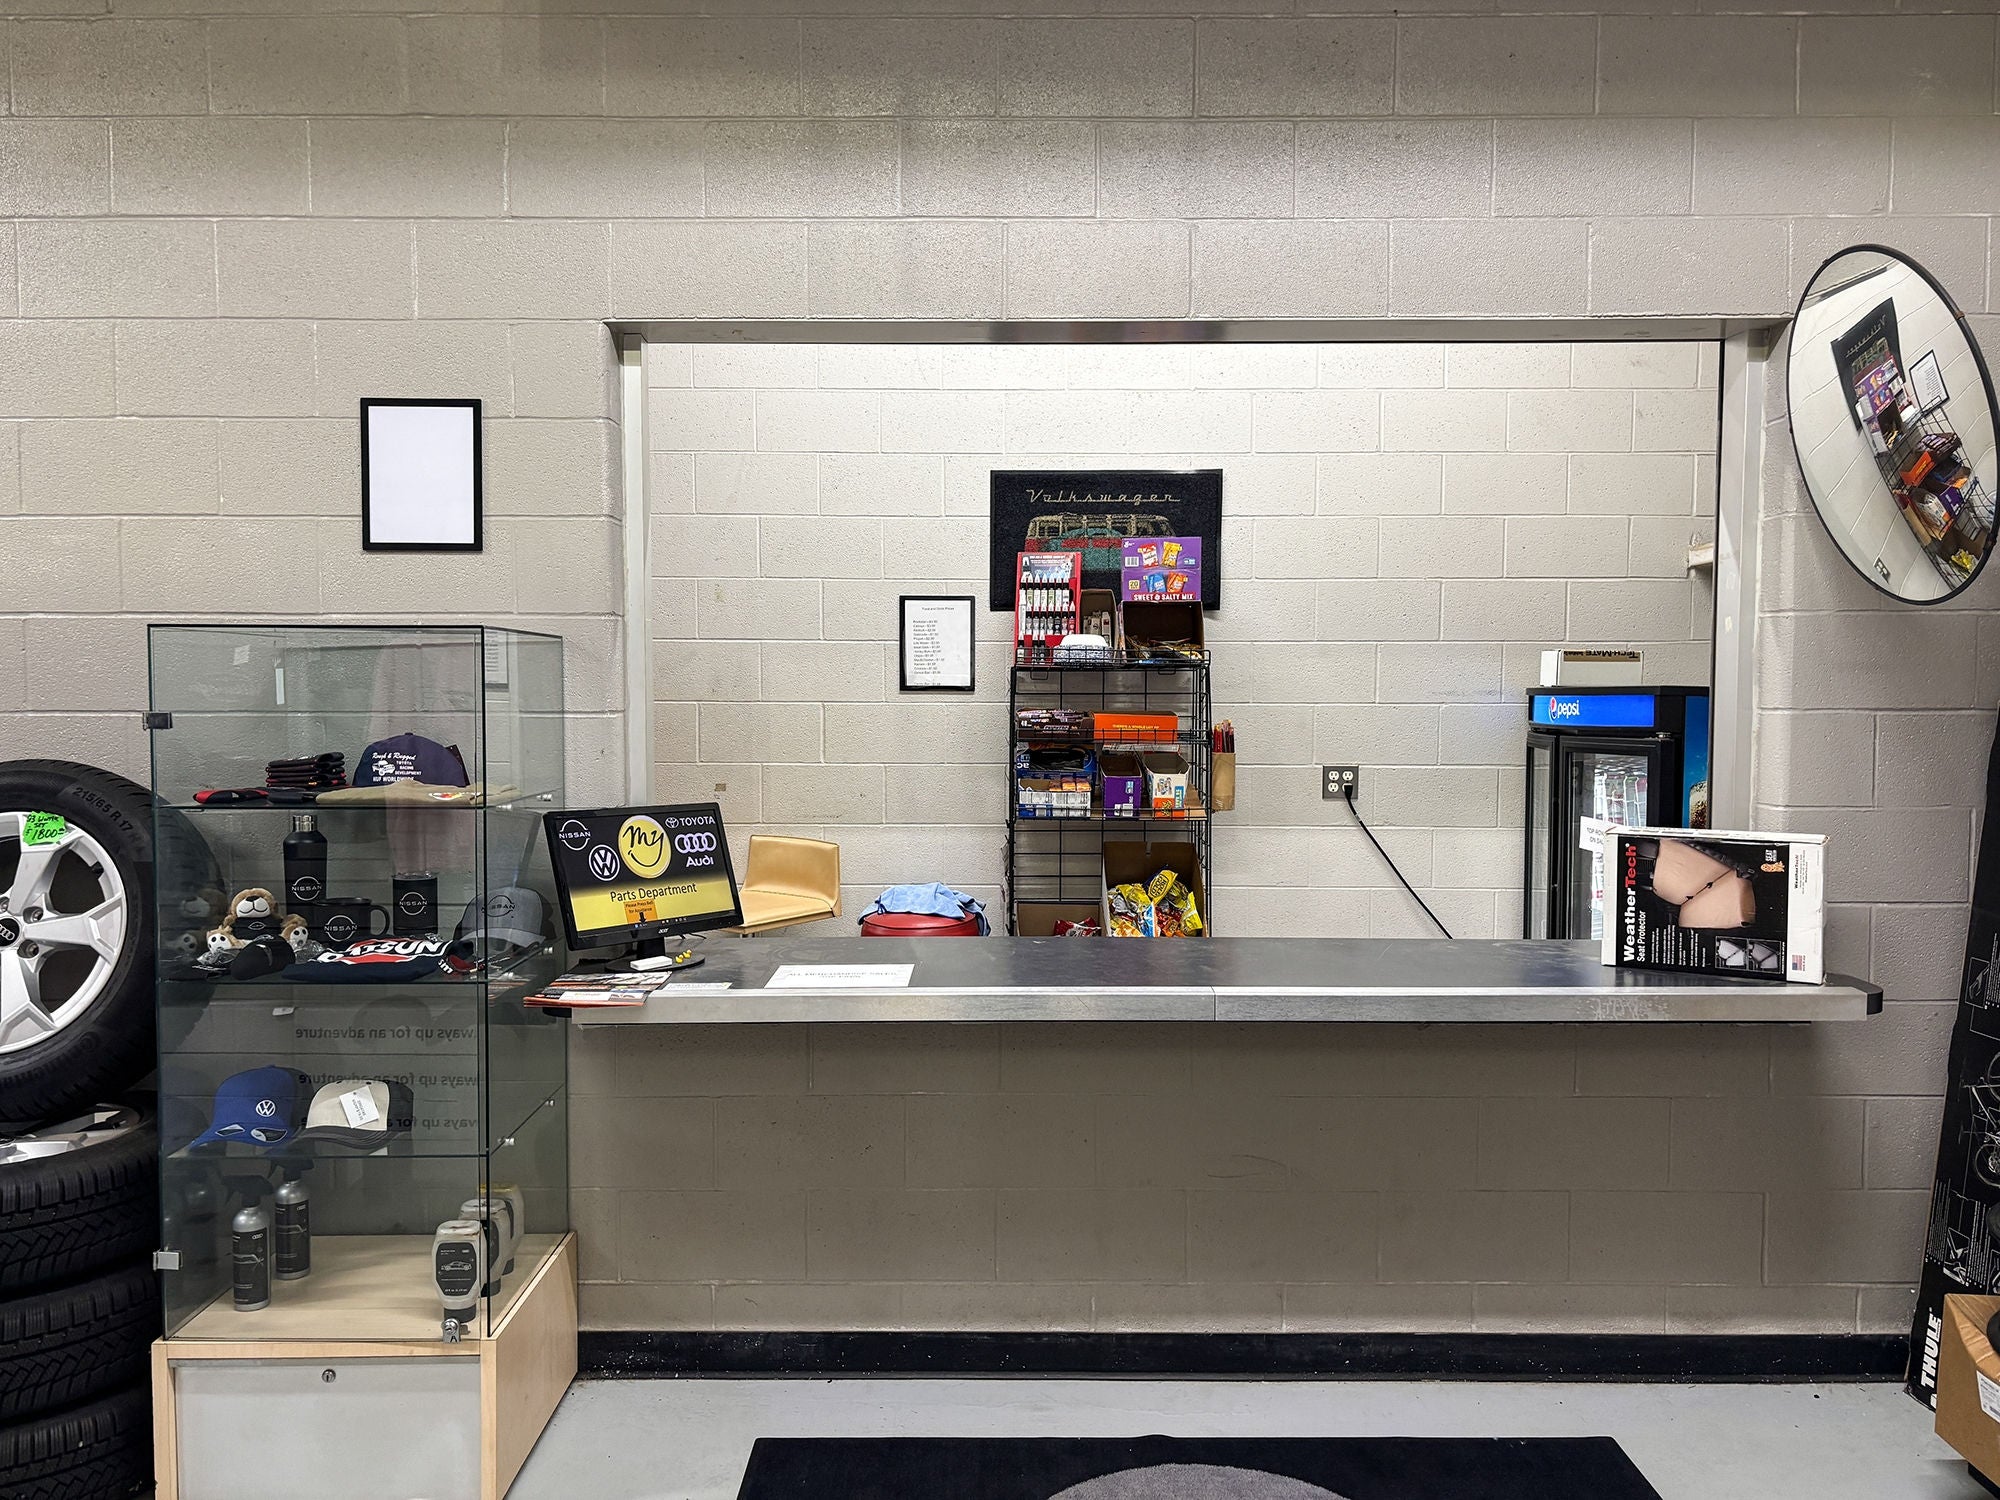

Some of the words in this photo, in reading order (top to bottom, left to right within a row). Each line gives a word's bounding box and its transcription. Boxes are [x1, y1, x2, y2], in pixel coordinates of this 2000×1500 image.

[1025, 489, 1180, 506] Volkswagen
[1557, 700, 1580, 718] pepsi
[393, 752, 416, 760] Rugged
[72, 787, 112, 813] 215/65
[110, 811, 122, 821] R
[120, 820, 133, 832] 17
[679, 816, 716, 827] TOYOTA
[559, 831, 591, 839] NISSAN
[686, 855, 714, 868] Audi
[610, 889, 636, 902] Parts
[638, 883, 697, 900] Department
[1624, 844, 1637, 962] WeatherTech
[1637, 910, 1646, 944] Protector
[1637, 946, 1646, 962] Seat
[1921, 1315, 1941, 1388] THULE
